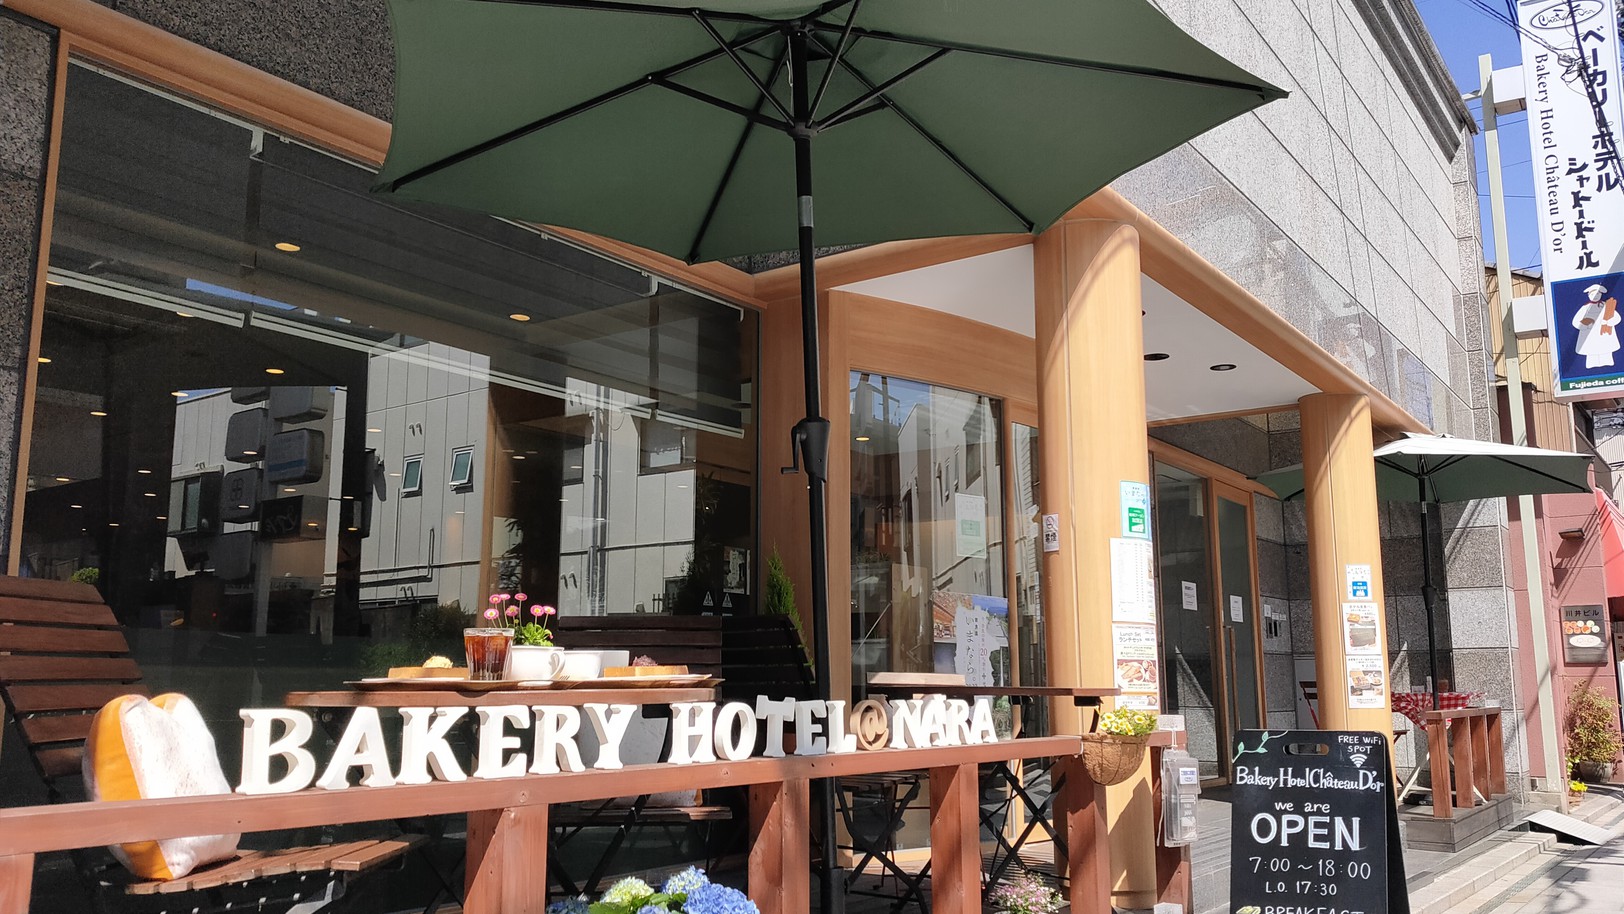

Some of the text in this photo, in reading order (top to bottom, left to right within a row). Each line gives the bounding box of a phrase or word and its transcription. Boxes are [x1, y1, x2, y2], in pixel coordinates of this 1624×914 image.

[1535, 53, 1550, 103] Bakery
[1581, 25, 1619, 193] ベーカリホテル
[1540, 108, 1557, 150] Hotel
[1544, 154, 1560, 216] Château
[1565, 157, 1600, 270] シャトードール
[1569, 379, 1604, 389] Fujieda
[1565, 609, 1600, 617] 川井ビル
[235, 702, 638, 795] BAKERY
[1338, 735, 1359, 745] FREE
[1236, 766, 1278, 789] Bakery
[1278, 767, 1309, 788] Hotel
[1309, 768, 1359, 790] Château
[1274, 802, 1331, 813] we are
[1250, 812, 1361, 851] OPEN
[1265, 881, 1338, 896] L.O. 17:30
